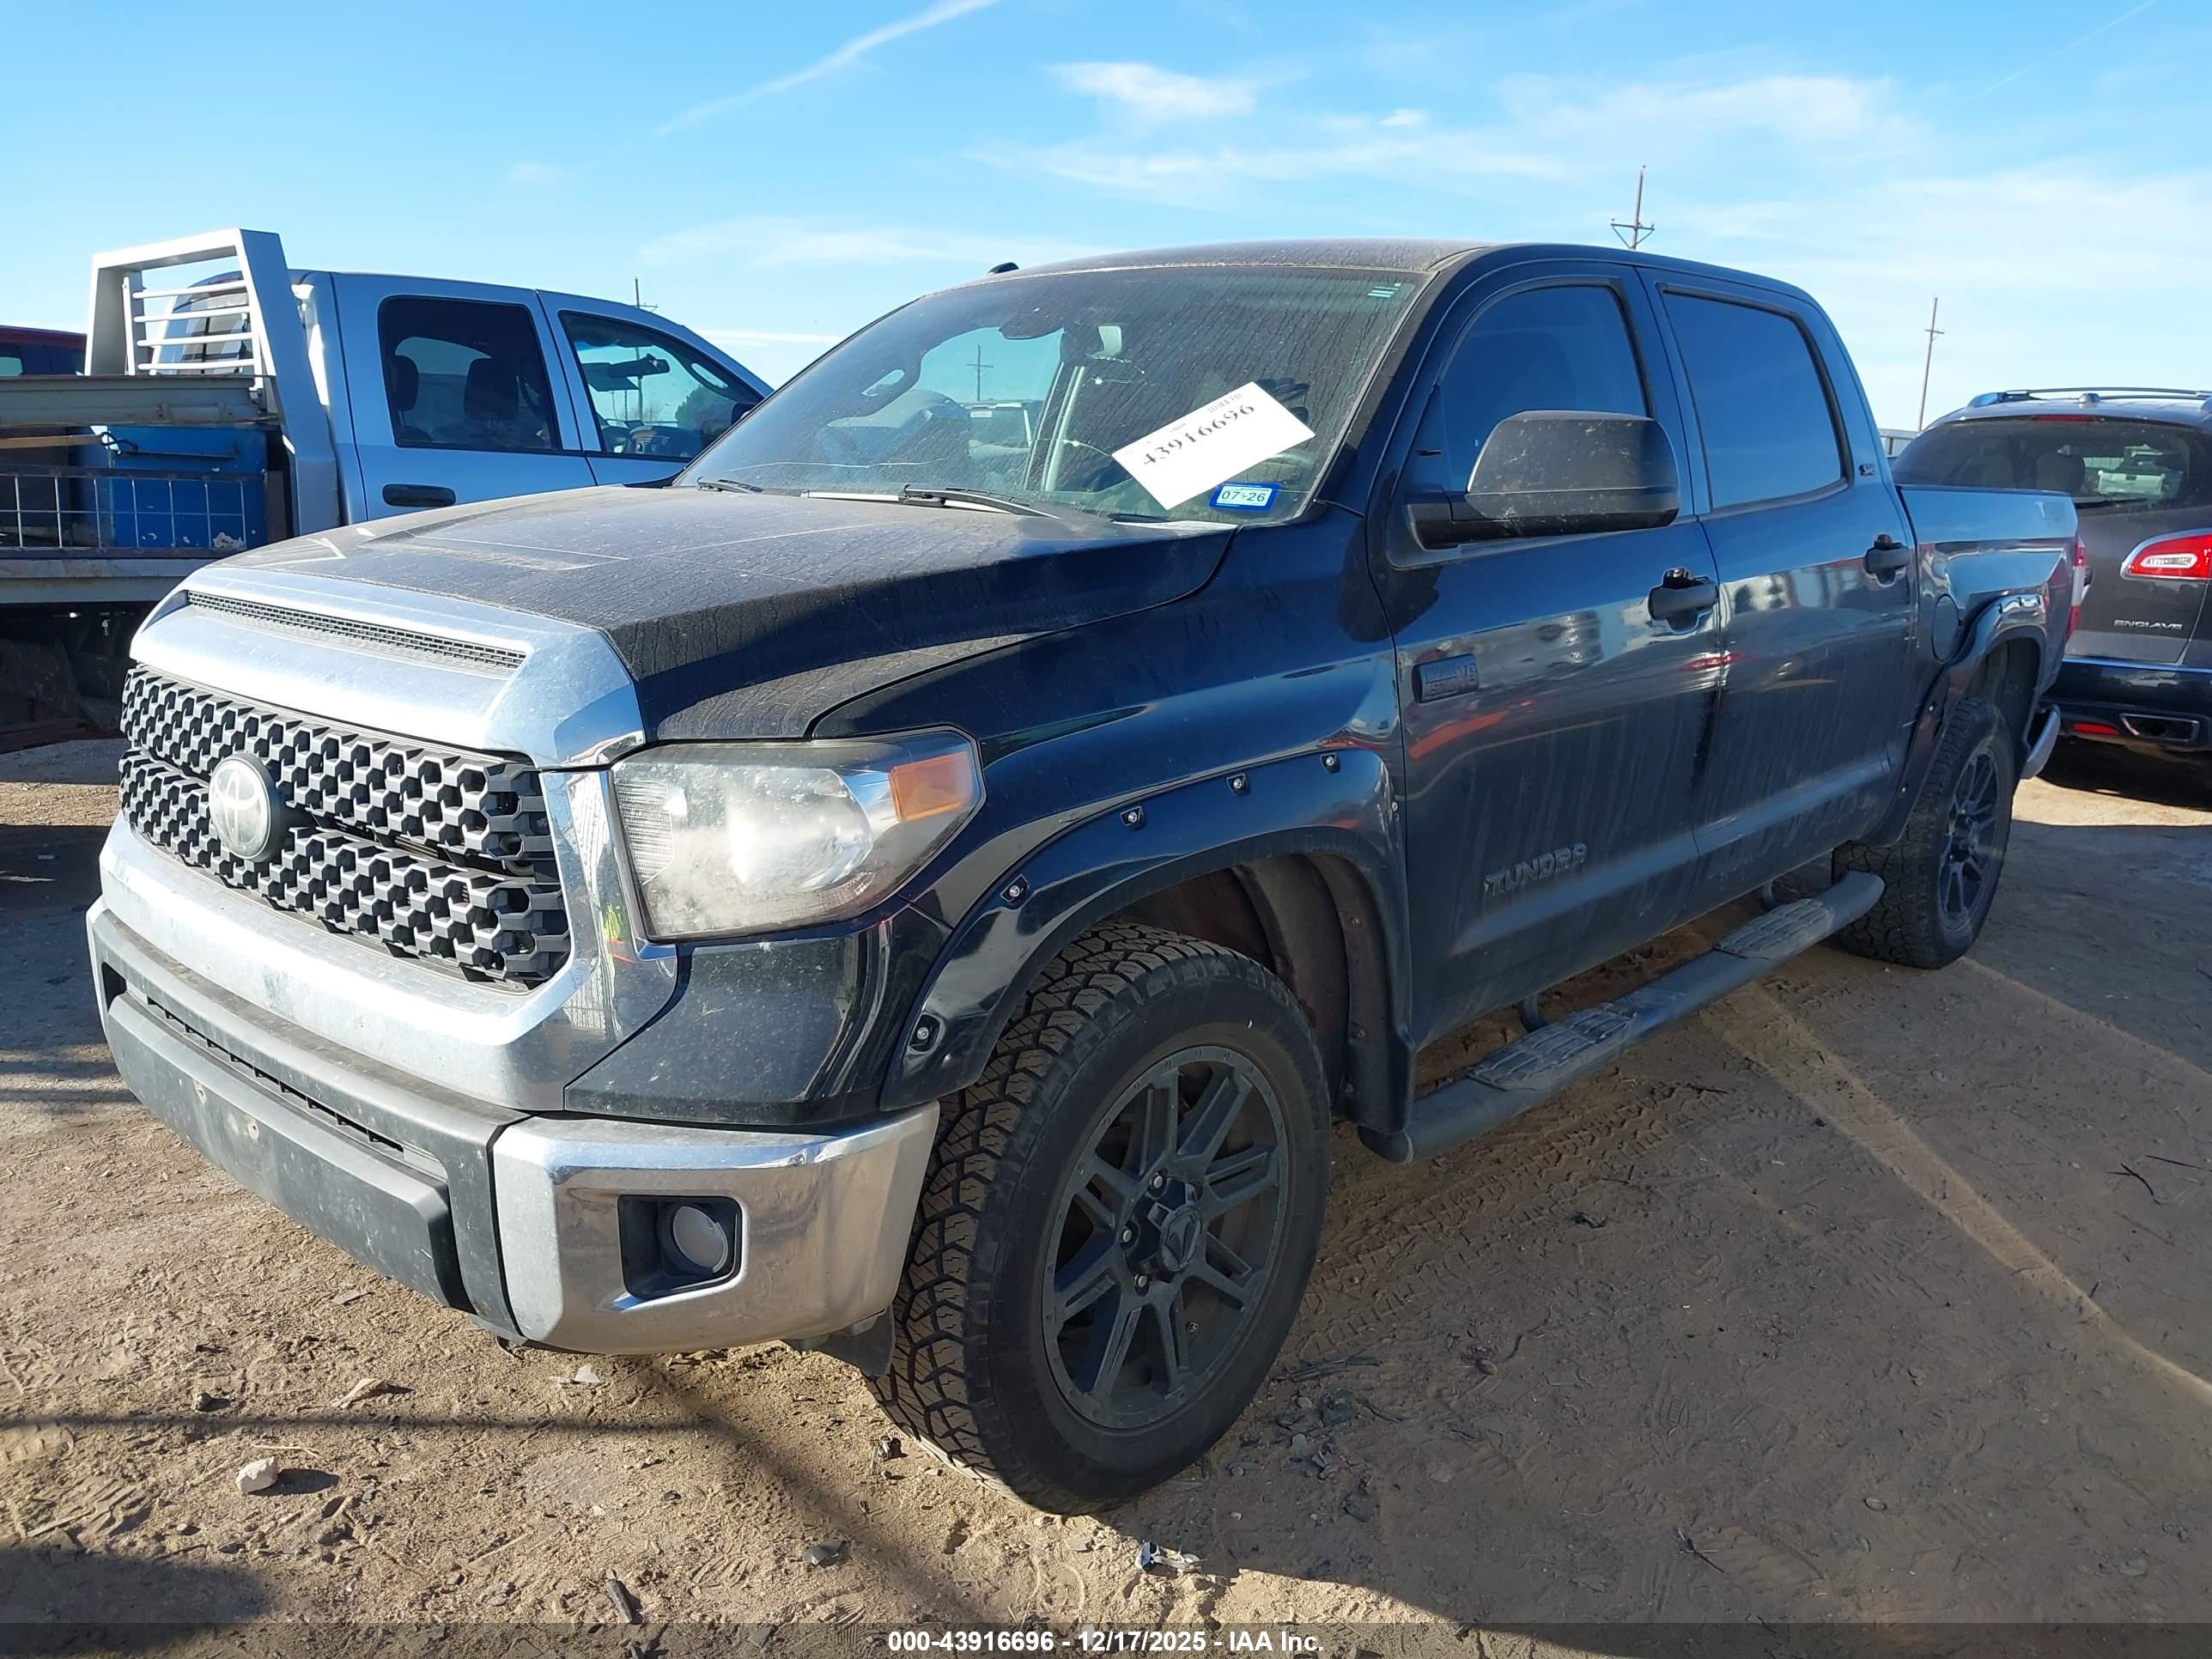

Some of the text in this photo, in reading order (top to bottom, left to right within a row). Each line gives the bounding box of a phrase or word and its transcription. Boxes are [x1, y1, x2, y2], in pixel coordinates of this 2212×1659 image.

[1142, 403, 1255, 465] 43916696
[1221, 490, 1267, 502] 07 26
